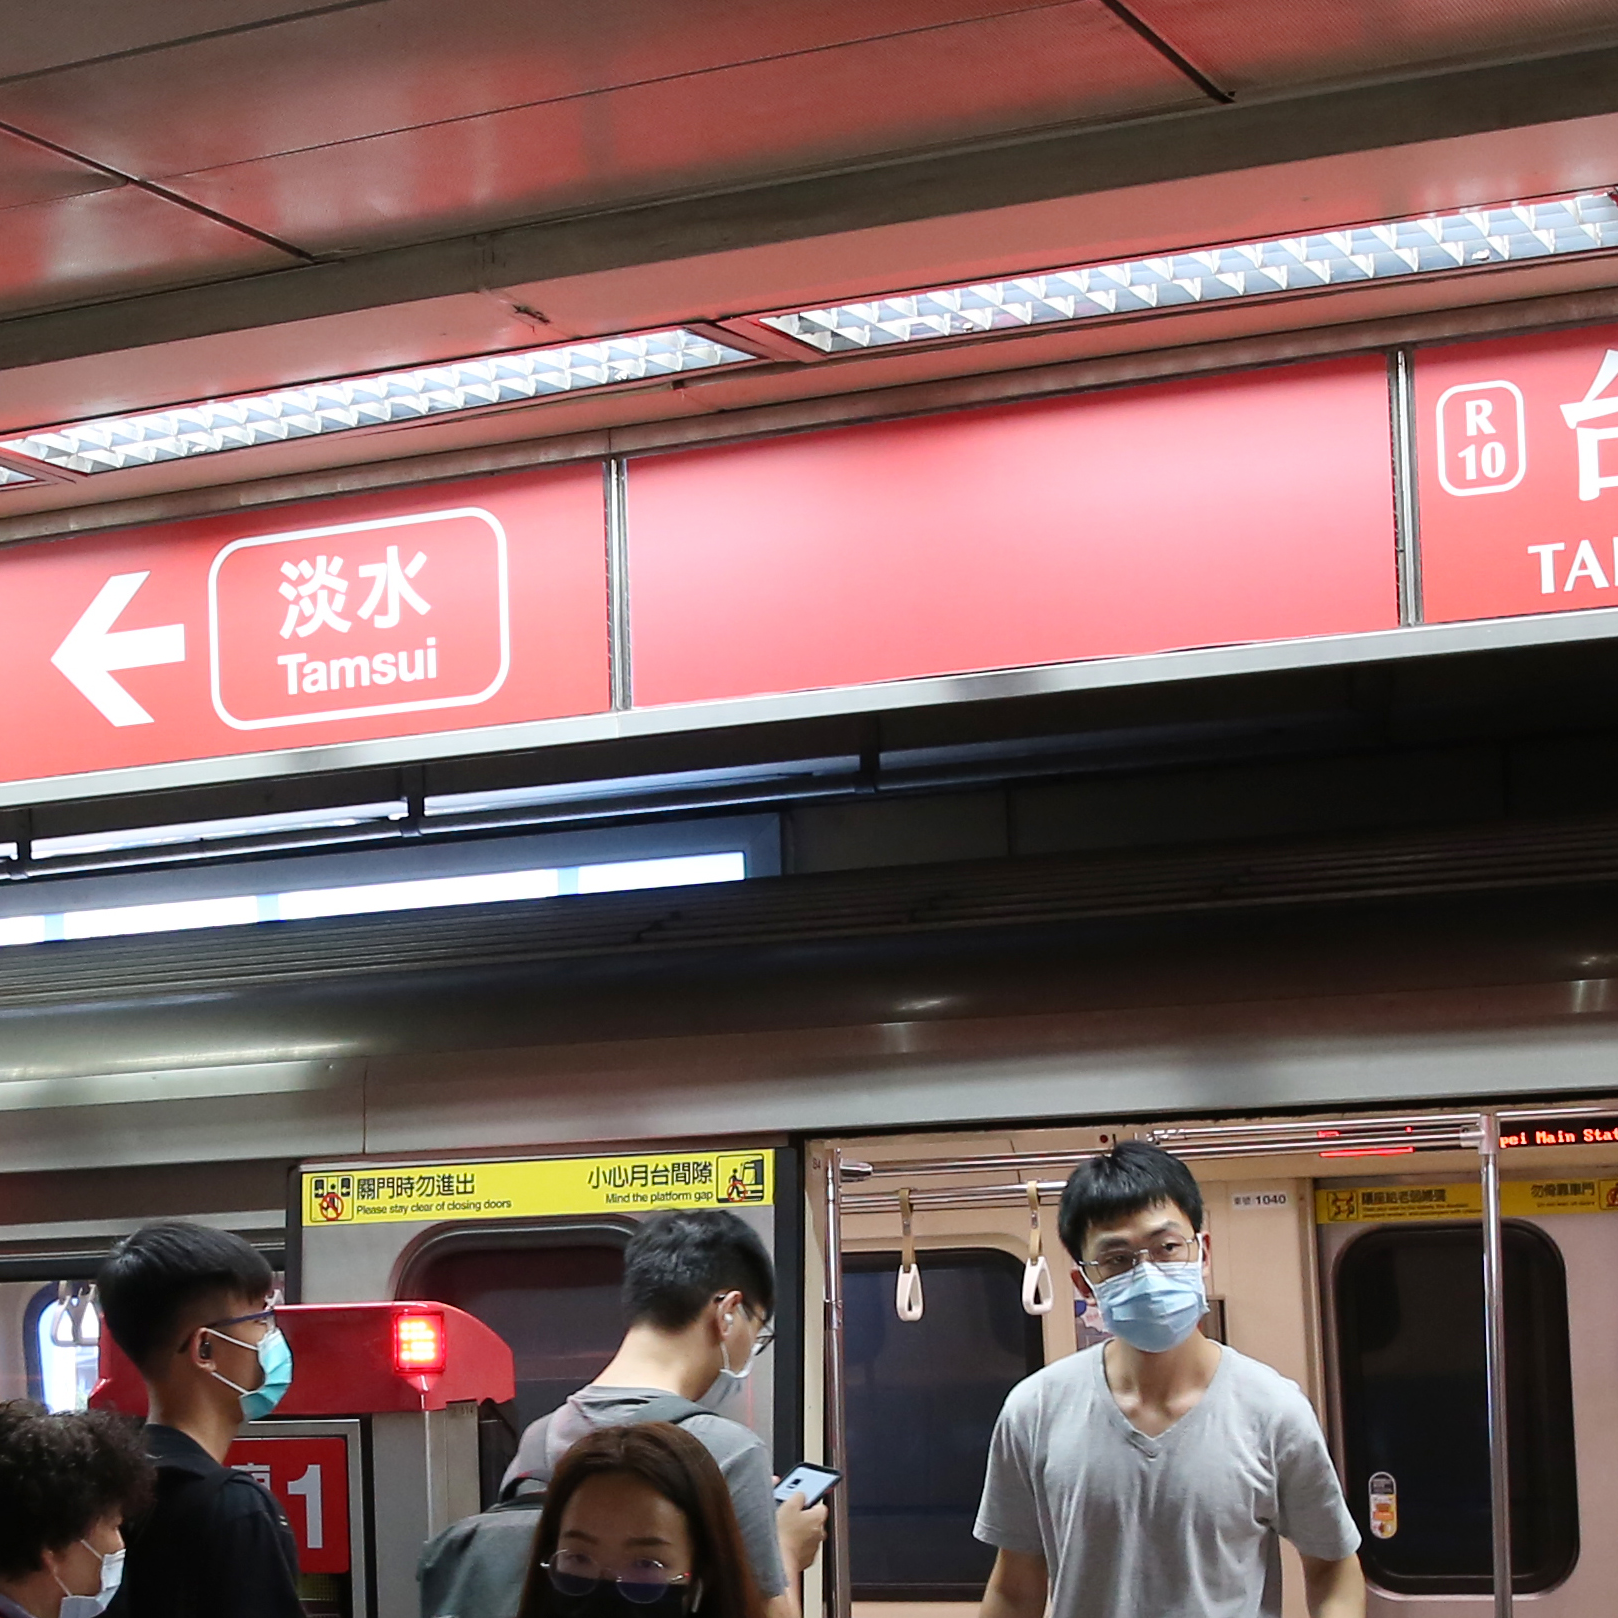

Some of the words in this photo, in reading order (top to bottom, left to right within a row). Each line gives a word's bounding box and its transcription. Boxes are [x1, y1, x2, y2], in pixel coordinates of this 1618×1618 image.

[1466, 398, 1494, 436] R
[1458, 437, 1506, 482] 10
[277, 545, 432, 640] 淡水
[277, 637, 438, 696] Tamsui
[1536, 1128, 1576, 1146] Main
[587, 1160, 713, 1189] 小心月台間隙
[356, 1204, 388, 1215] Please
[389, 1203, 409, 1216] stay
[411, 1202, 433, 1213] clear
[435, 1201, 445, 1212] of
[447, 1200, 482, 1212] closing
[483, 1199, 512, 1209] doors
[605, 1193, 630, 1204] Mind
[632, 1192, 648, 1203] the
[650, 1190, 692, 1204] platform
[694, 1191, 713, 1203] gap
[1255, 1194, 1287, 1206] 1040
[287, 1464, 323, 1549] 1
